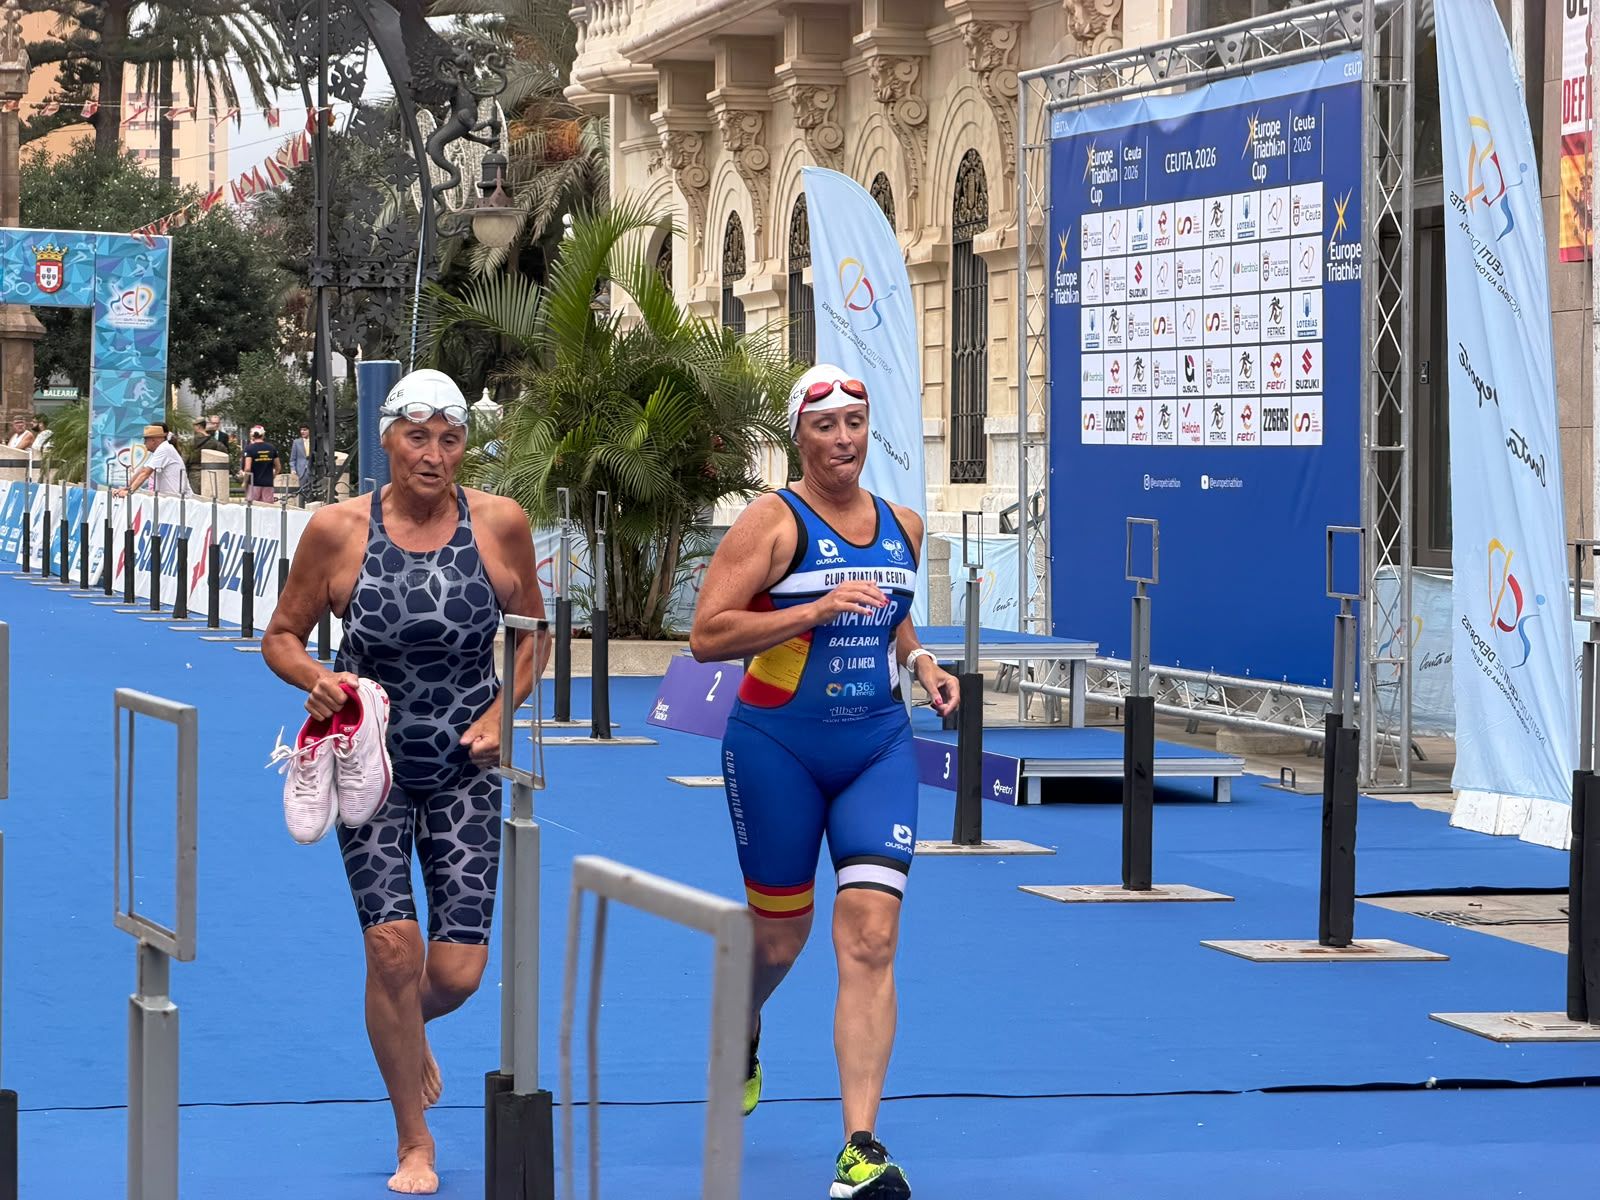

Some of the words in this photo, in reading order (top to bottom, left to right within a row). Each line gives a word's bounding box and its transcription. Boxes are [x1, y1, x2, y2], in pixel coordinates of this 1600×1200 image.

[1253, 120, 1281, 139] Europe
[1293, 114, 1315, 132] Ceuta
[1253, 138, 1286, 160] Triathlon
[1293, 135, 1312, 153] 2026
[1090, 149, 1113, 167] Europe
[1123, 146, 1142, 161] Ceuta
[1165, 151, 1194, 173] CEUTA
[1195, 147, 1216, 169] 2026
[1090, 165, 1118, 185] Triathlon
[1123, 165, 1139, 181] 2026
[1252, 161, 1267, 183] Cup
[1090, 186, 1103, 207] Cup
[1330, 241, 1361, 260] Europe
[1056, 270, 1078, 288] Europe
[1054, 287, 1080, 305] Triathlon
[1129, 288, 1149, 299] SUZUKI
[1295, 379, 1320, 390] SUZUKI
[1263, 407, 1289, 432] 226ERS
[825, 572, 845, 586] CLUB
[886, 571, 907, 585] CEUTA
[829, 636, 880, 647] BALEARIA
[848, 657, 857, 669] LA
[858, 656, 875, 669] MECA
[706, 670, 722, 701] 2
[943, 752, 951, 779] 3
[725, 750, 736, 774] CLUB
[736, 820, 749, 846] CEUTA
